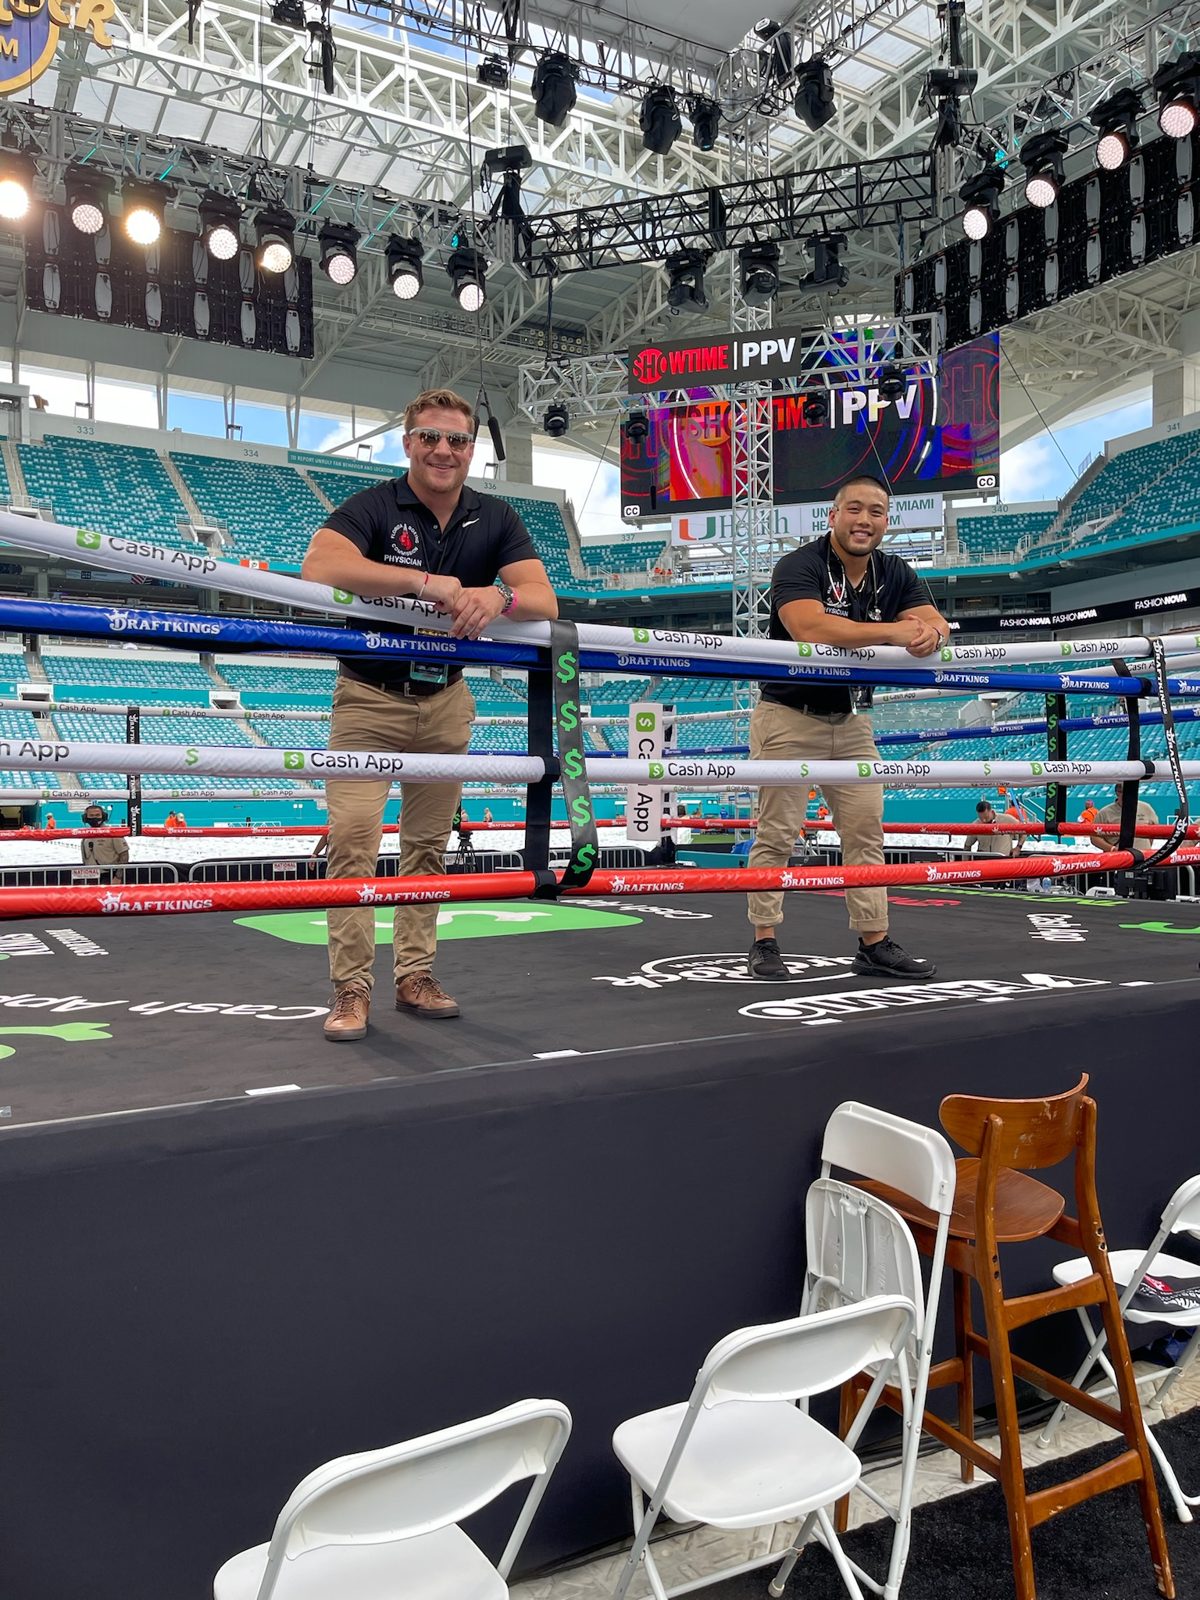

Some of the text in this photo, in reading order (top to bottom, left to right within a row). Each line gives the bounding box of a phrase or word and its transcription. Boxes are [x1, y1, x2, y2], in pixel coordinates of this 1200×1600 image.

[632, 337, 796, 384] SHOWTIME PPV
[76, 425, 95, 436] 333
[1166, 422, 1181, 433] 341
[243, 448, 259, 458] 334
[483, 482, 497, 490] 336
[896, 498, 935, 512] MIAMI
[992, 505, 1009, 513] 340
[621, 533, 636, 542] 337
[171, 552, 217, 574] App
[383, 554, 422, 566] PHYSICIAN
[825, 607, 849, 617] YSICIAN
[107, 611, 220, 635] DRAFTKINGS
[365, 632, 457, 653] DRAFTKINGS
[652, 629, 690, 644] Cash
[693, 634, 723, 649] App
[814, 643, 847, 657] Cash
[850, 648, 876, 661] App
[954, 647, 982, 659] Cash
[984, 646, 1007, 660] App
[1073, 642, 1097, 653] Cash
[1100, 641, 1119, 655] App
[618, 653, 691, 667] DRAFTKINGS
[788, 664, 851, 677] DRAFTKINGS
[934, 671, 990, 684] DRAFTKINGS
[1061, 677, 1110, 690] DRAFTKINGS
[59, 703, 79, 711] Cash
[19, 741, 70, 762] App
[310, 752, 359, 768] Cash
[365, 754, 404, 774] App
[668, 762, 703, 777] Cash
[706, 763, 736, 778] App
[873, 762, 904, 775] Cash
[906, 762, 931, 777] App
[1043, 762, 1070, 773] Cash
[1071, 762, 1092, 775] App
[633, 792, 653, 833] App
[1053, 859, 1101, 873] DRAFTKINGS
[781, 875, 845, 889] DRAFTKINGS
[927, 869, 982, 882] DRAFTKINGS
[611, 881, 685, 893] DRAFTKINGS
[359, 889, 451, 904] DRAFTKINGS
[101, 898, 213, 913] DRAFTKINGS
[128, 1001, 331, 1020] Cash
